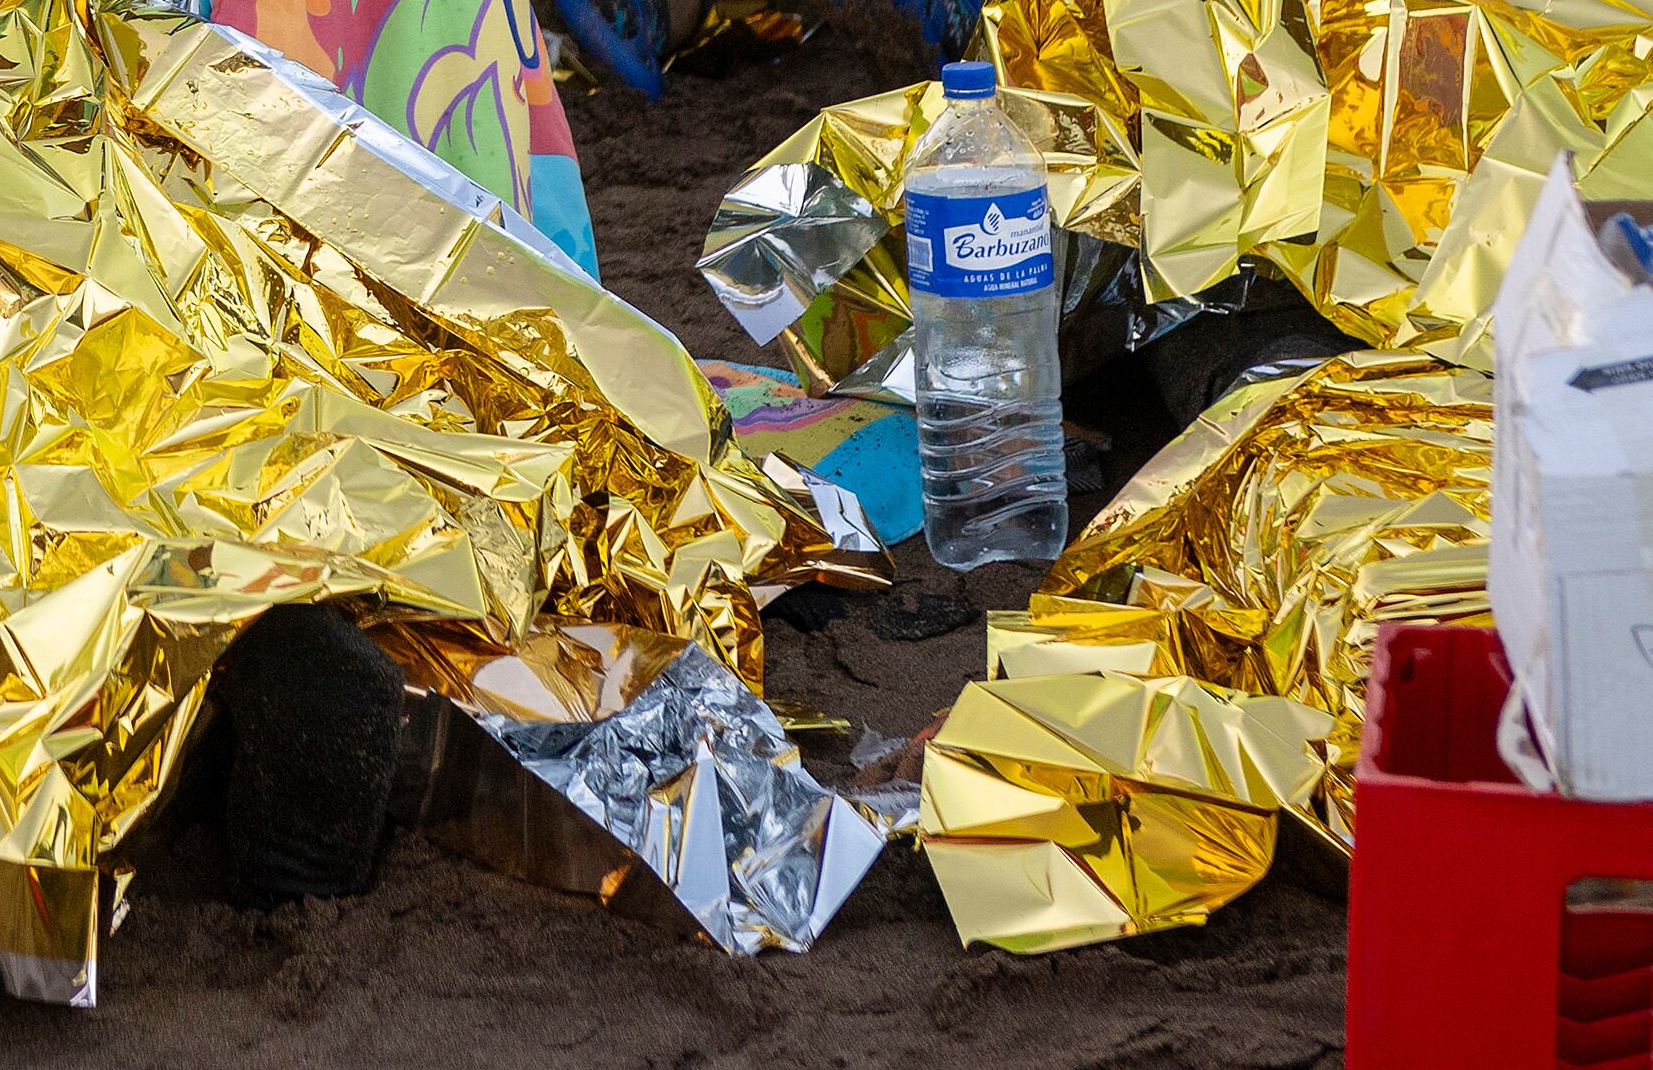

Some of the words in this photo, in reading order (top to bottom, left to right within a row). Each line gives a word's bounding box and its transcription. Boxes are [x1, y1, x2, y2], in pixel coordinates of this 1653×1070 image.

[952, 233, 1049, 259] Barbuzano
[963, 273, 994, 283] AGUAS
[999, 272, 1010, 281] DE
[1015, 270, 1026, 279] LA
